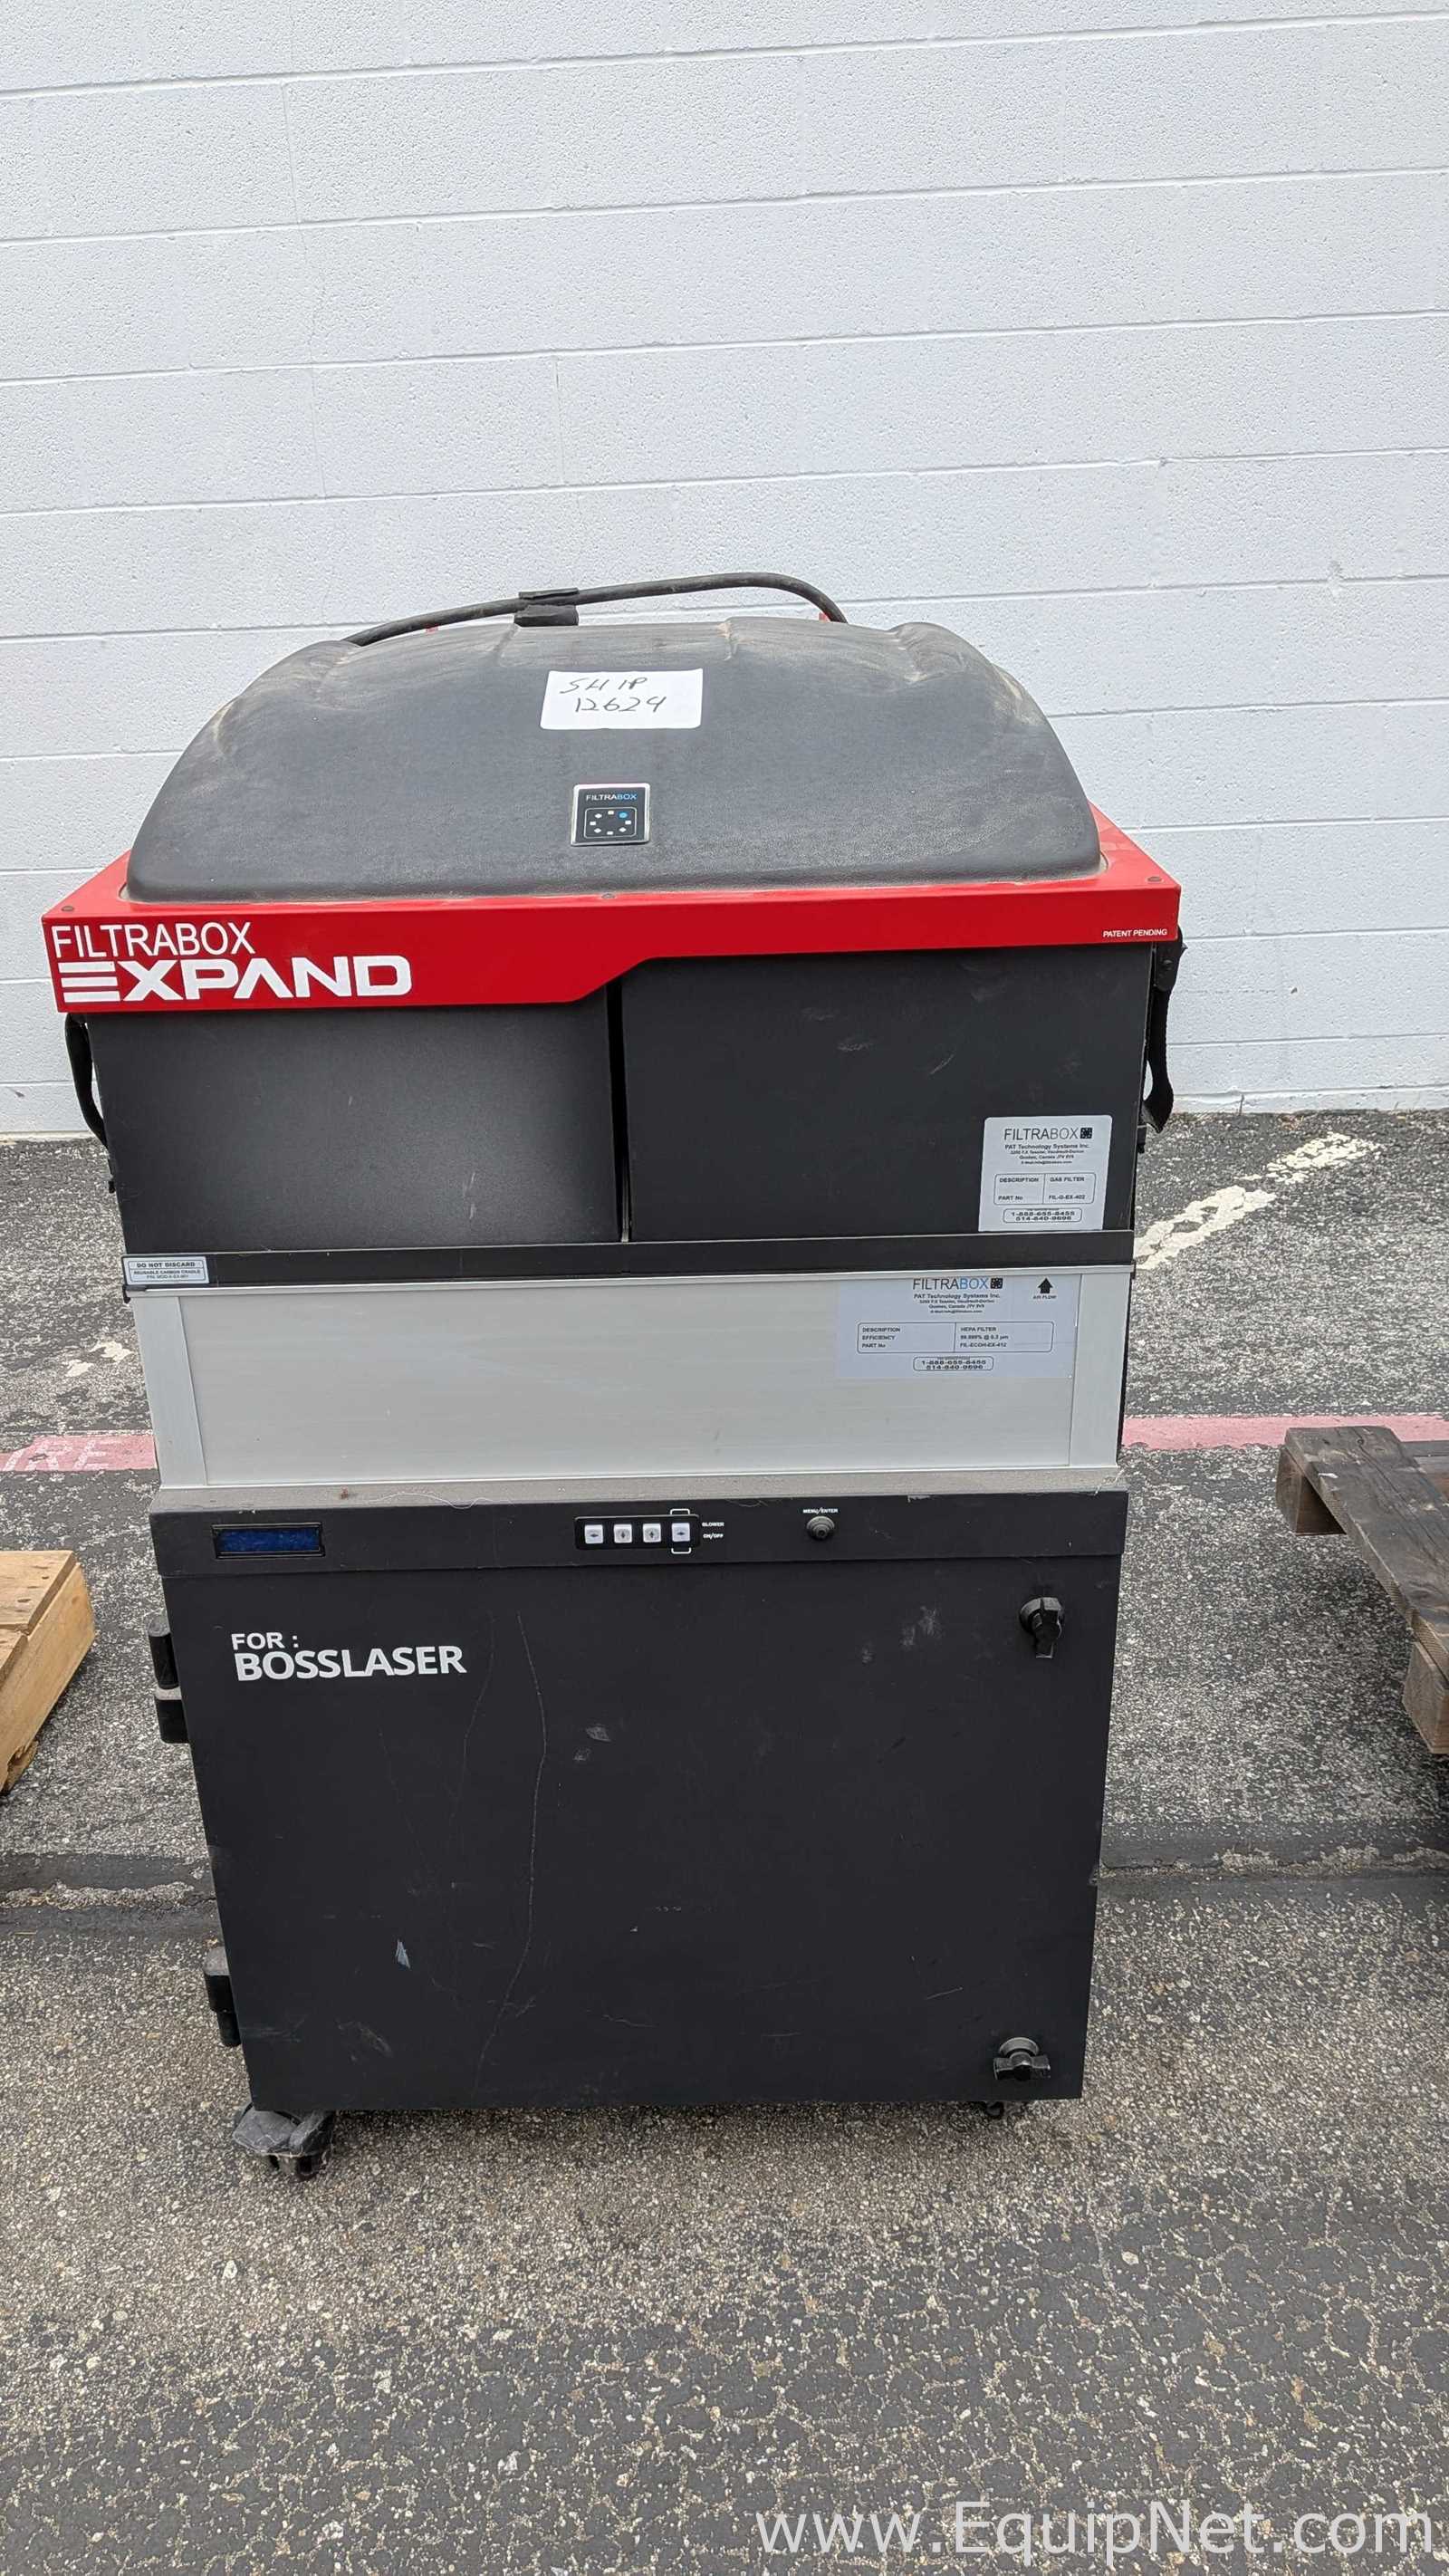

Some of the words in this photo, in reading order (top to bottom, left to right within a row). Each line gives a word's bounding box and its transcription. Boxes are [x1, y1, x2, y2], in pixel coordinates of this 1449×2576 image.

[574, 696, 667, 713] 12624
[585, 793, 638, 801] FILTRABOX
[51, 921, 255, 957] FILTRABOX
[1102, 929, 1132, 937] PATENT
[1133, 928, 1167, 937] PENDING
[57, 955, 412, 1004] EXPAND
[1003, 1127, 1079, 1140] FILTRABOX
[913, 1277, 989, 1290] FILTRABOX
[234, 1645, 467, 1681] BOSSLASER
